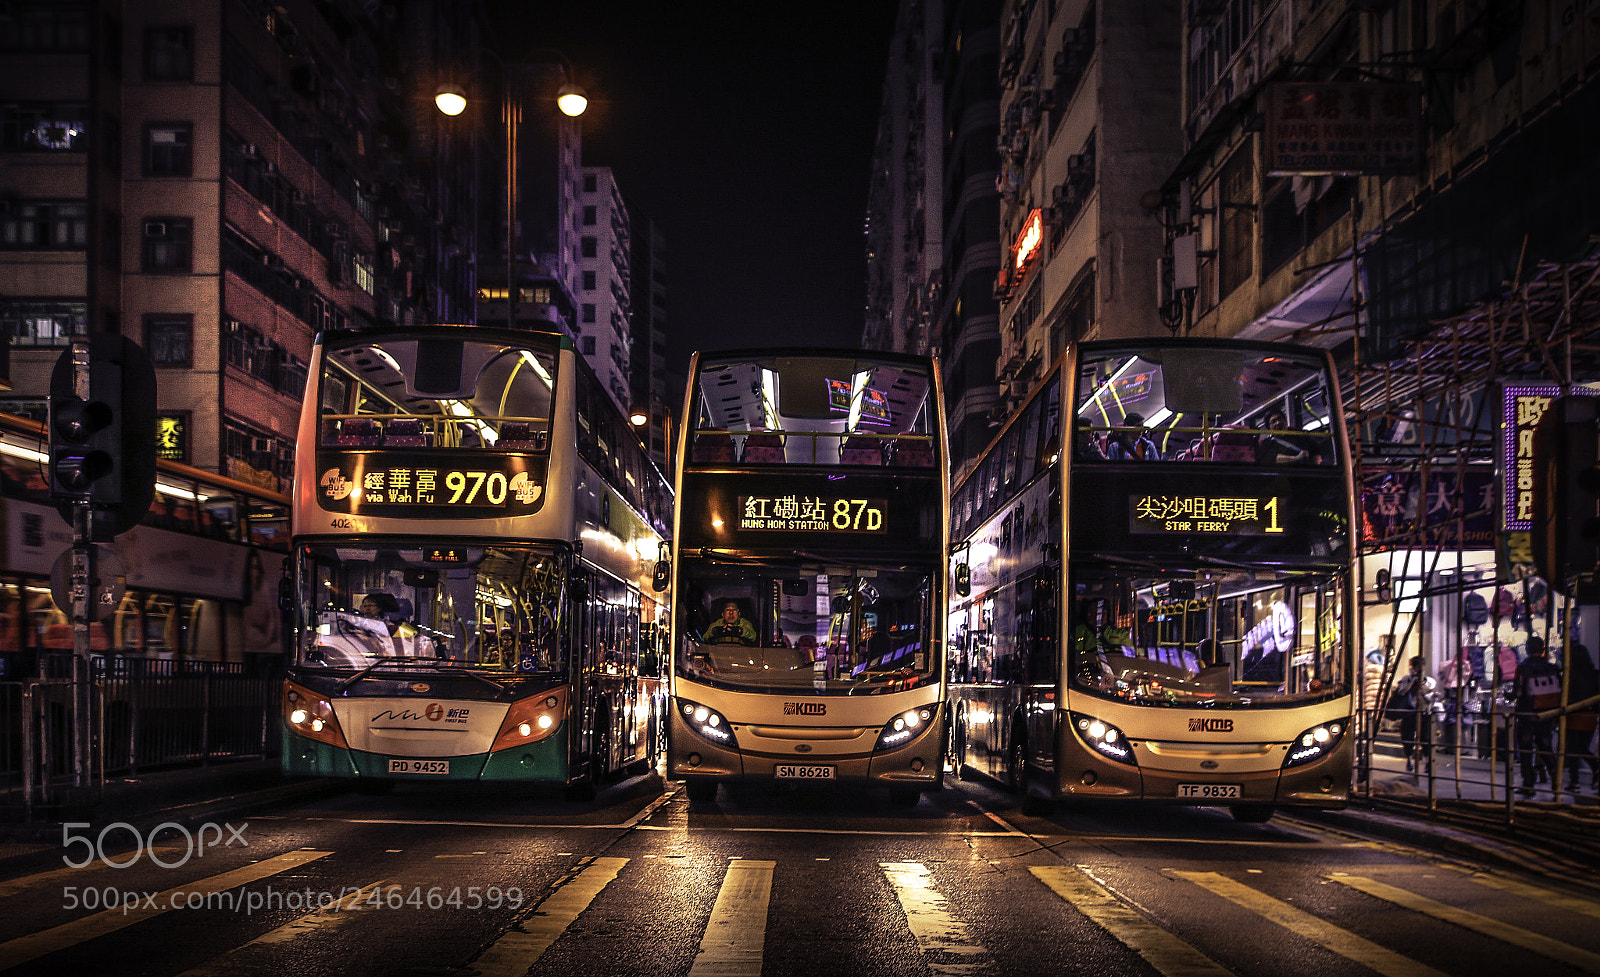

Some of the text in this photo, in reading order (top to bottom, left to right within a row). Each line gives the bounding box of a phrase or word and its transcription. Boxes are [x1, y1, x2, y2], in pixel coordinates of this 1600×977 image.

[1277, 124, 1318, 138] MANG
[1324, 124, 1363, 138] KWAN
[446, 471, 507, 505] 970
[366, 489, 434, 503] via Wah Fu
[744, 495, 882, 531] 紅磡站 87D
[1136, 495, 1284, 533] 尖沙咀碼頭 1
[742, 519, 830, 531] HUNG HOM STATION
[1165, 521, 1230, 532] STAR FERRY
[446, 708, 469, 719] 新巴
[795, 703, 827, 716] KMB
[1201, 718, 1234, 732] KMB
[392, 761, 446, 773] PD 9452
[780, 766, 830, 778] SN 8628
[1182, 785, 1236, 797] TF 9832
